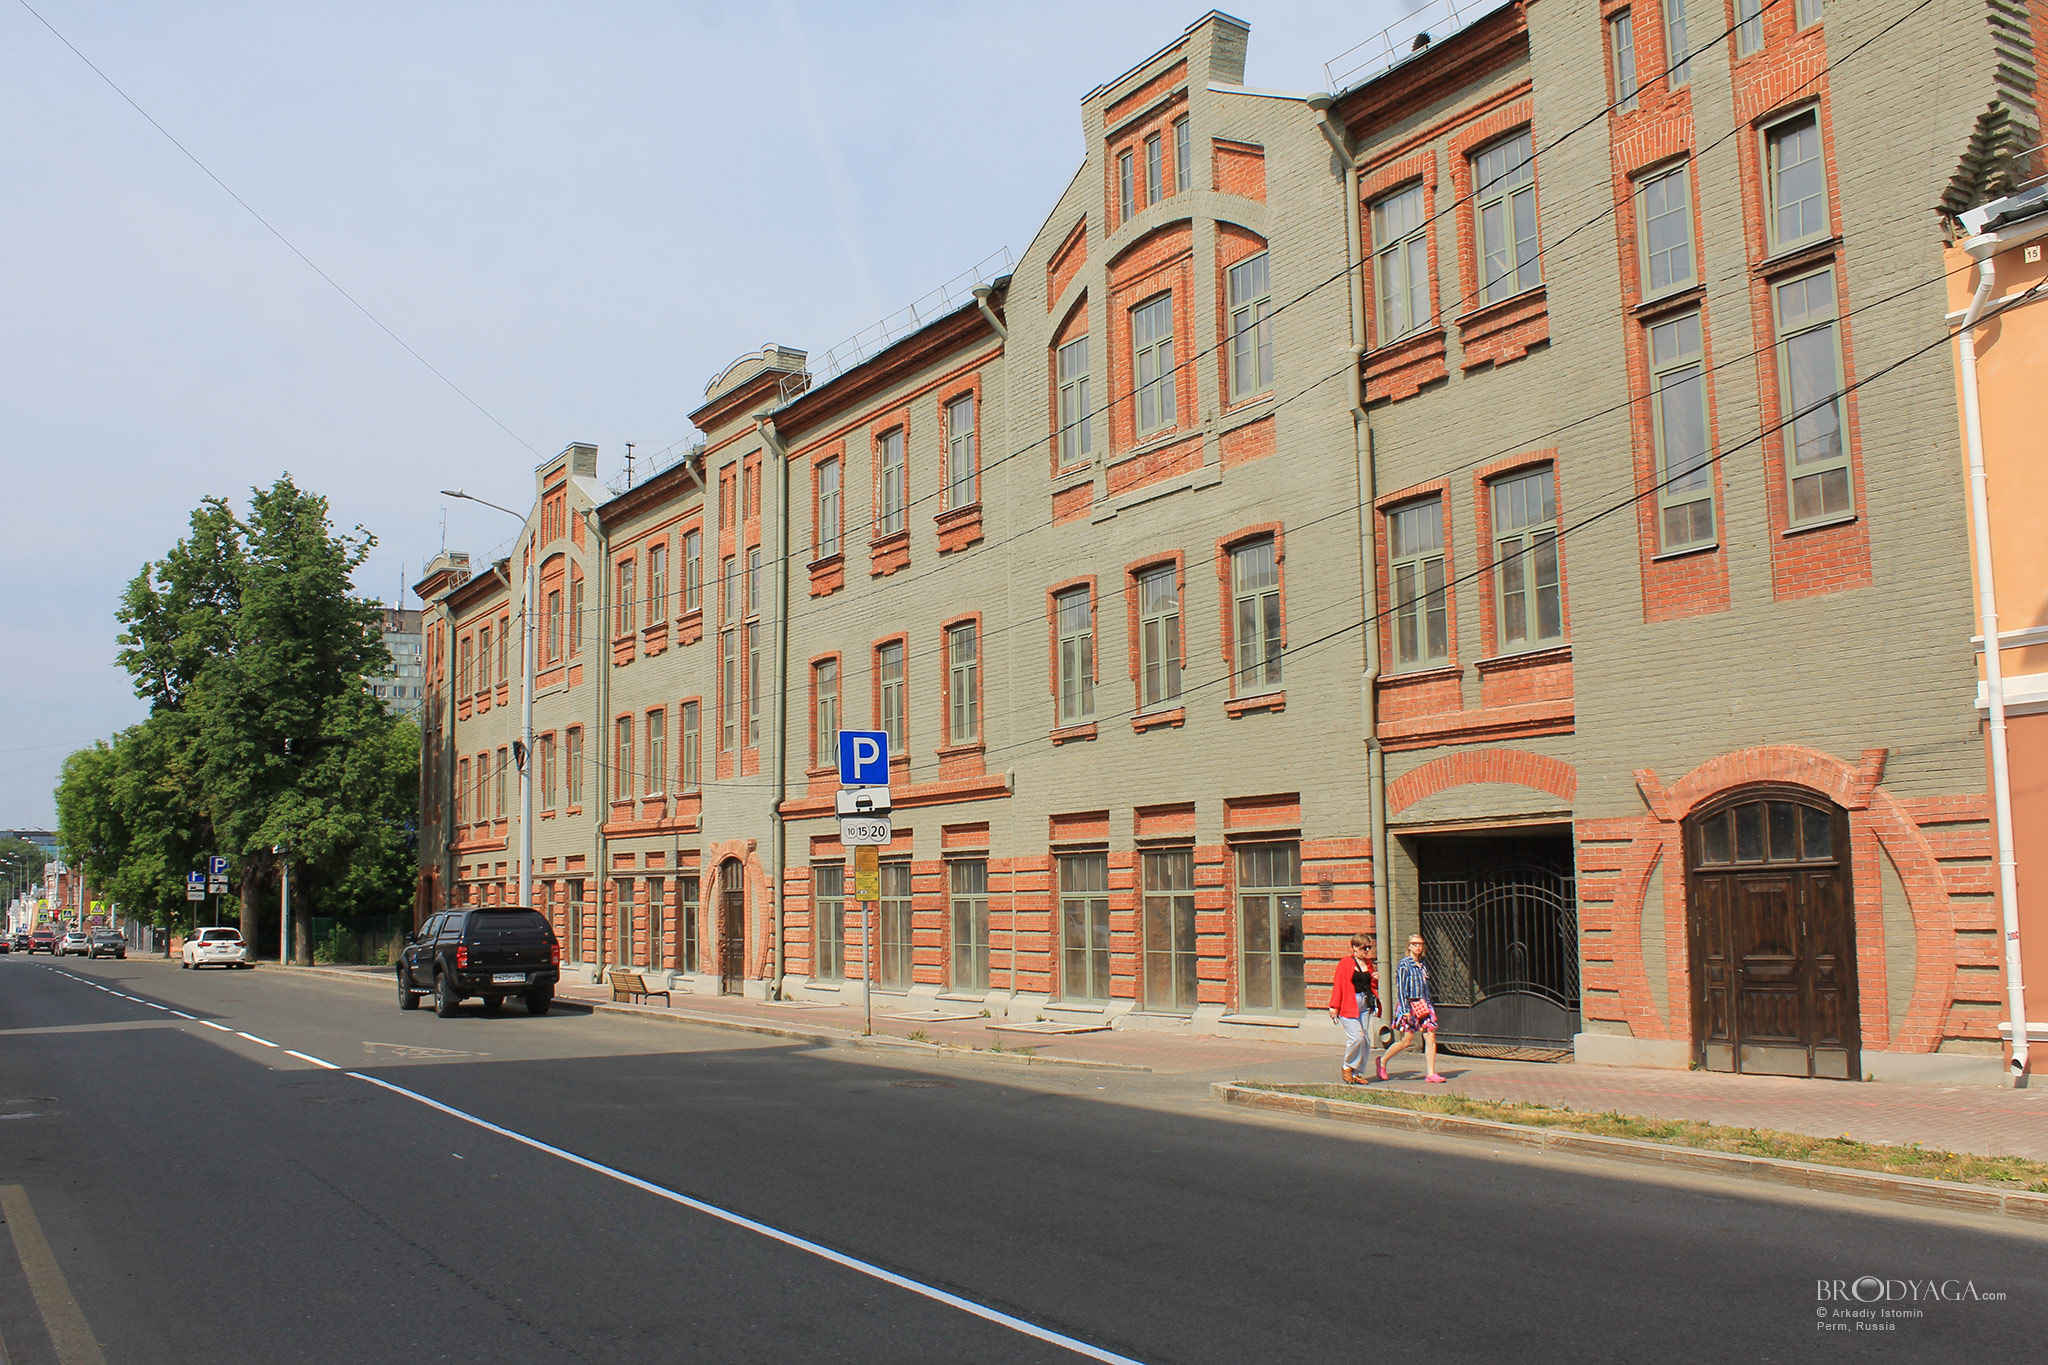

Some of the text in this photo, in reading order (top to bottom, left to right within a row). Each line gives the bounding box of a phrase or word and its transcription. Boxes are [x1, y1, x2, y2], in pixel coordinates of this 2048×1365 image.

[2027, 249, 2038, 259] 15
[853, 737, 880, 779] P
[847, 825, 886, 837] 10 15 20
[215, 858, 226, 873] P
